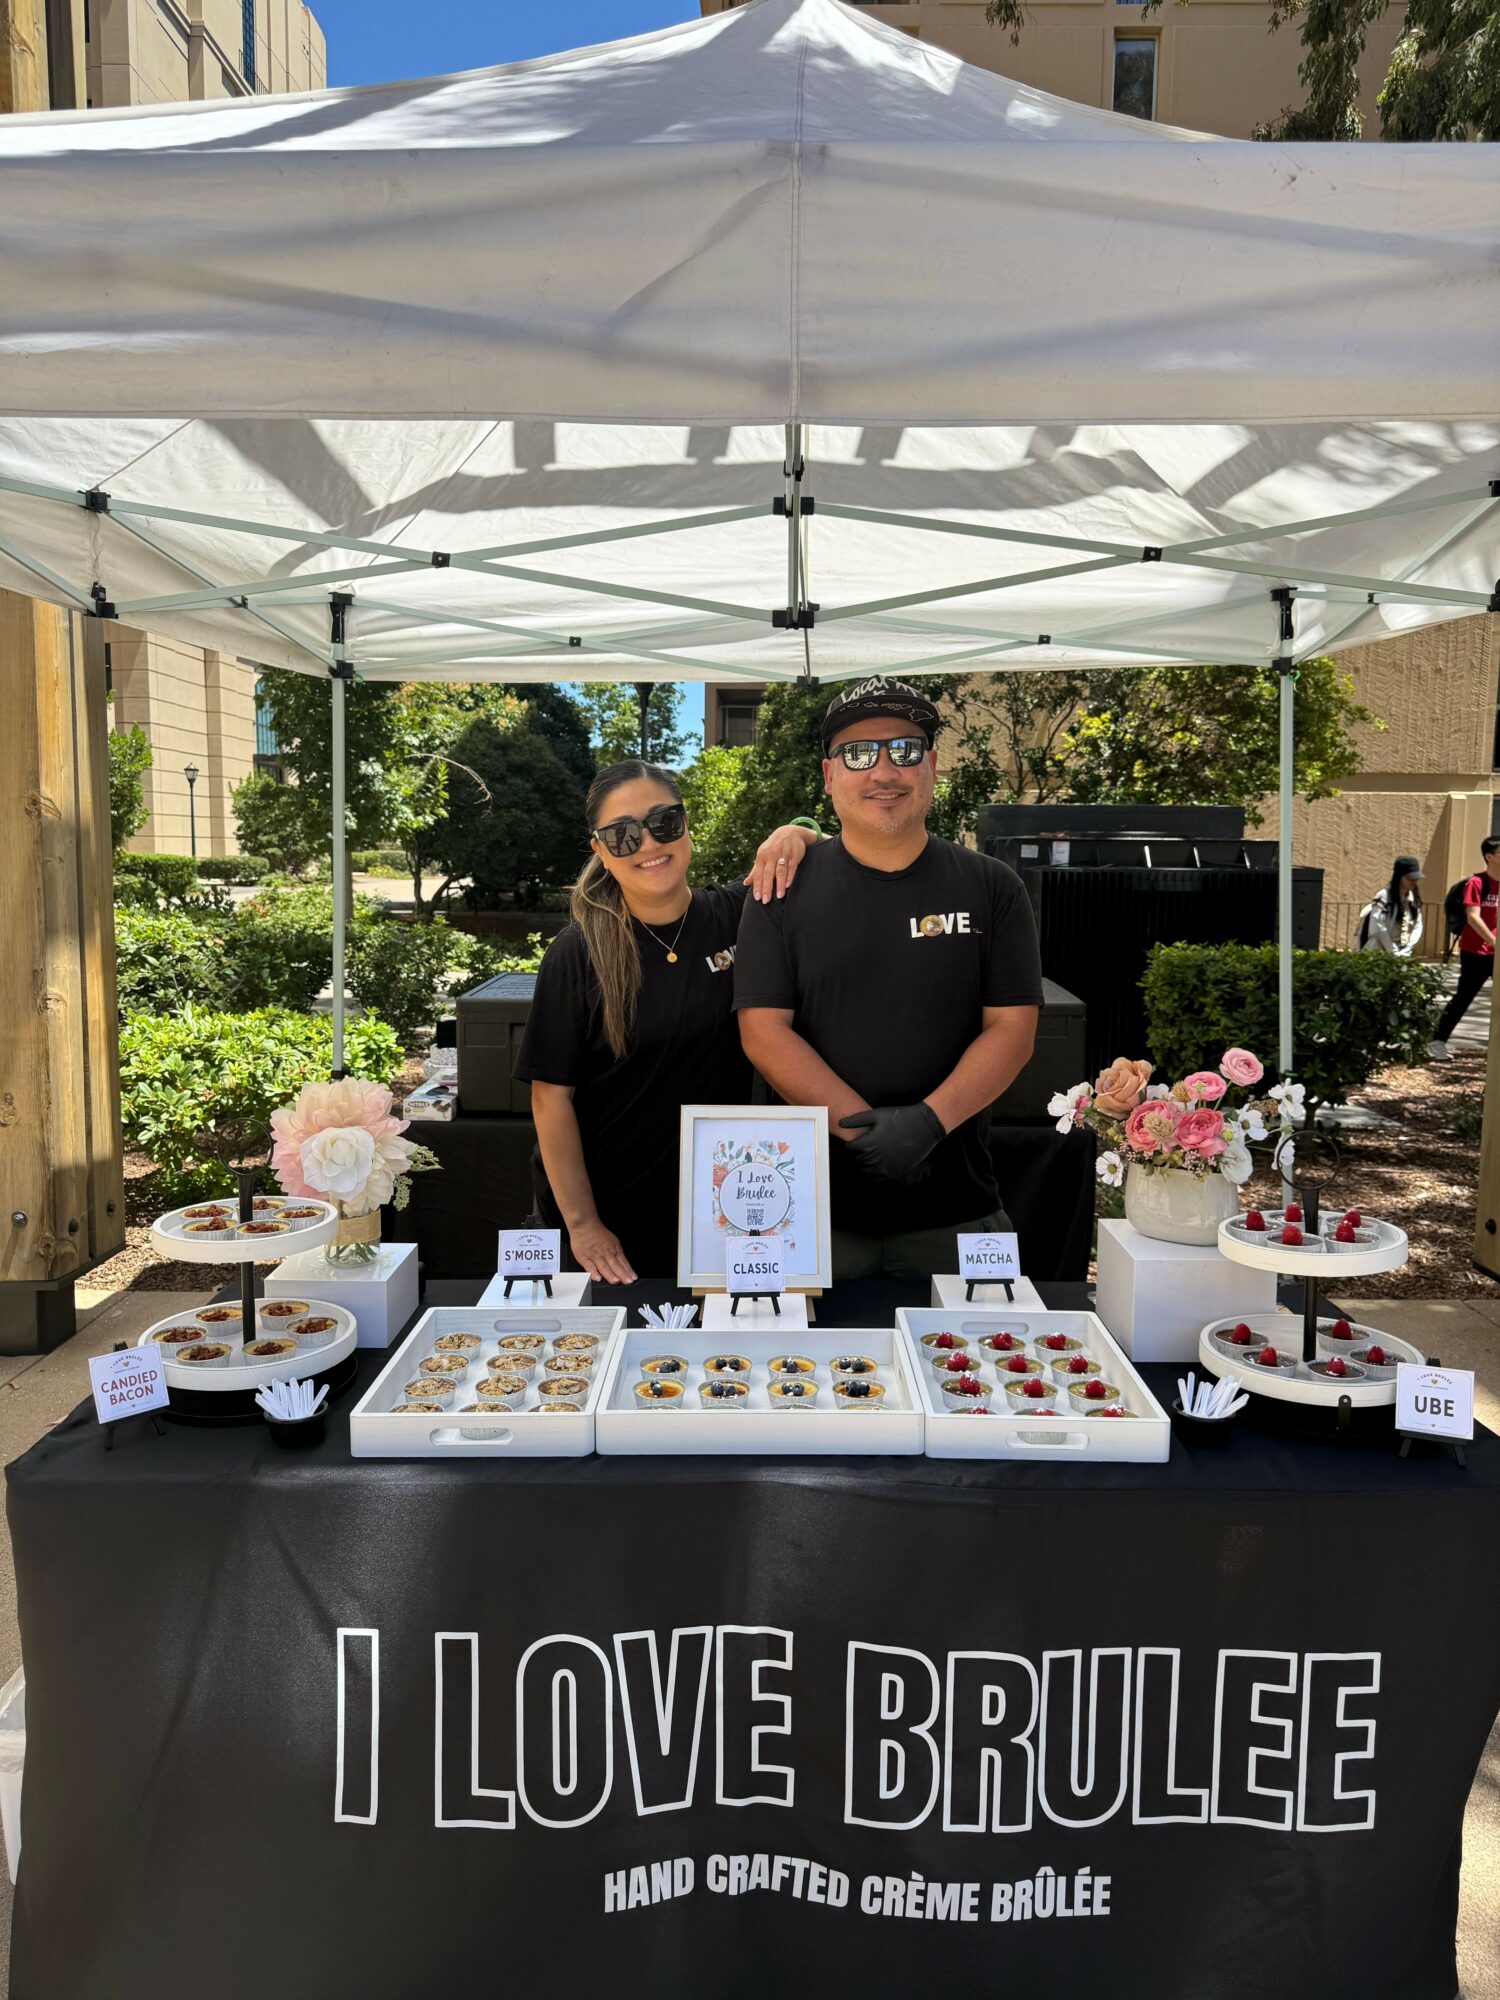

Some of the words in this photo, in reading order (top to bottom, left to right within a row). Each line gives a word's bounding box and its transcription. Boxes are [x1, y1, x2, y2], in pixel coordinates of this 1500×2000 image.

[910, 912, 971, 938] LOVE
[737, 1170, 743, 1183] I
[747, 1171, 775, 1184] Love
[736, 1185, 777, 1200] Brulee
[504, 1249, 554, 1261] S'MORES
[965, 1253, 1013, 1265] MATCHA
[733, 1262, 779, 1275] CLASSIC
[101, 1369, 158, 1393] CANDIED
[109, 1384, 154, 1405] BACON
[1414, 1395, 1455, 1418] UBE
[333, 1626, 380, 1826] I
[433, 1624, 795, 1830] LOVE
[843, 1640, 1382, 1834] BRULEE
[604, 1857, 695, 1913] HAND
[706, 1853, 850, 1908] CRAFTED
[860, 1870, 981, 1922] CRÈME
[990, 1866, 1112, 1922] BRÛLÉE
